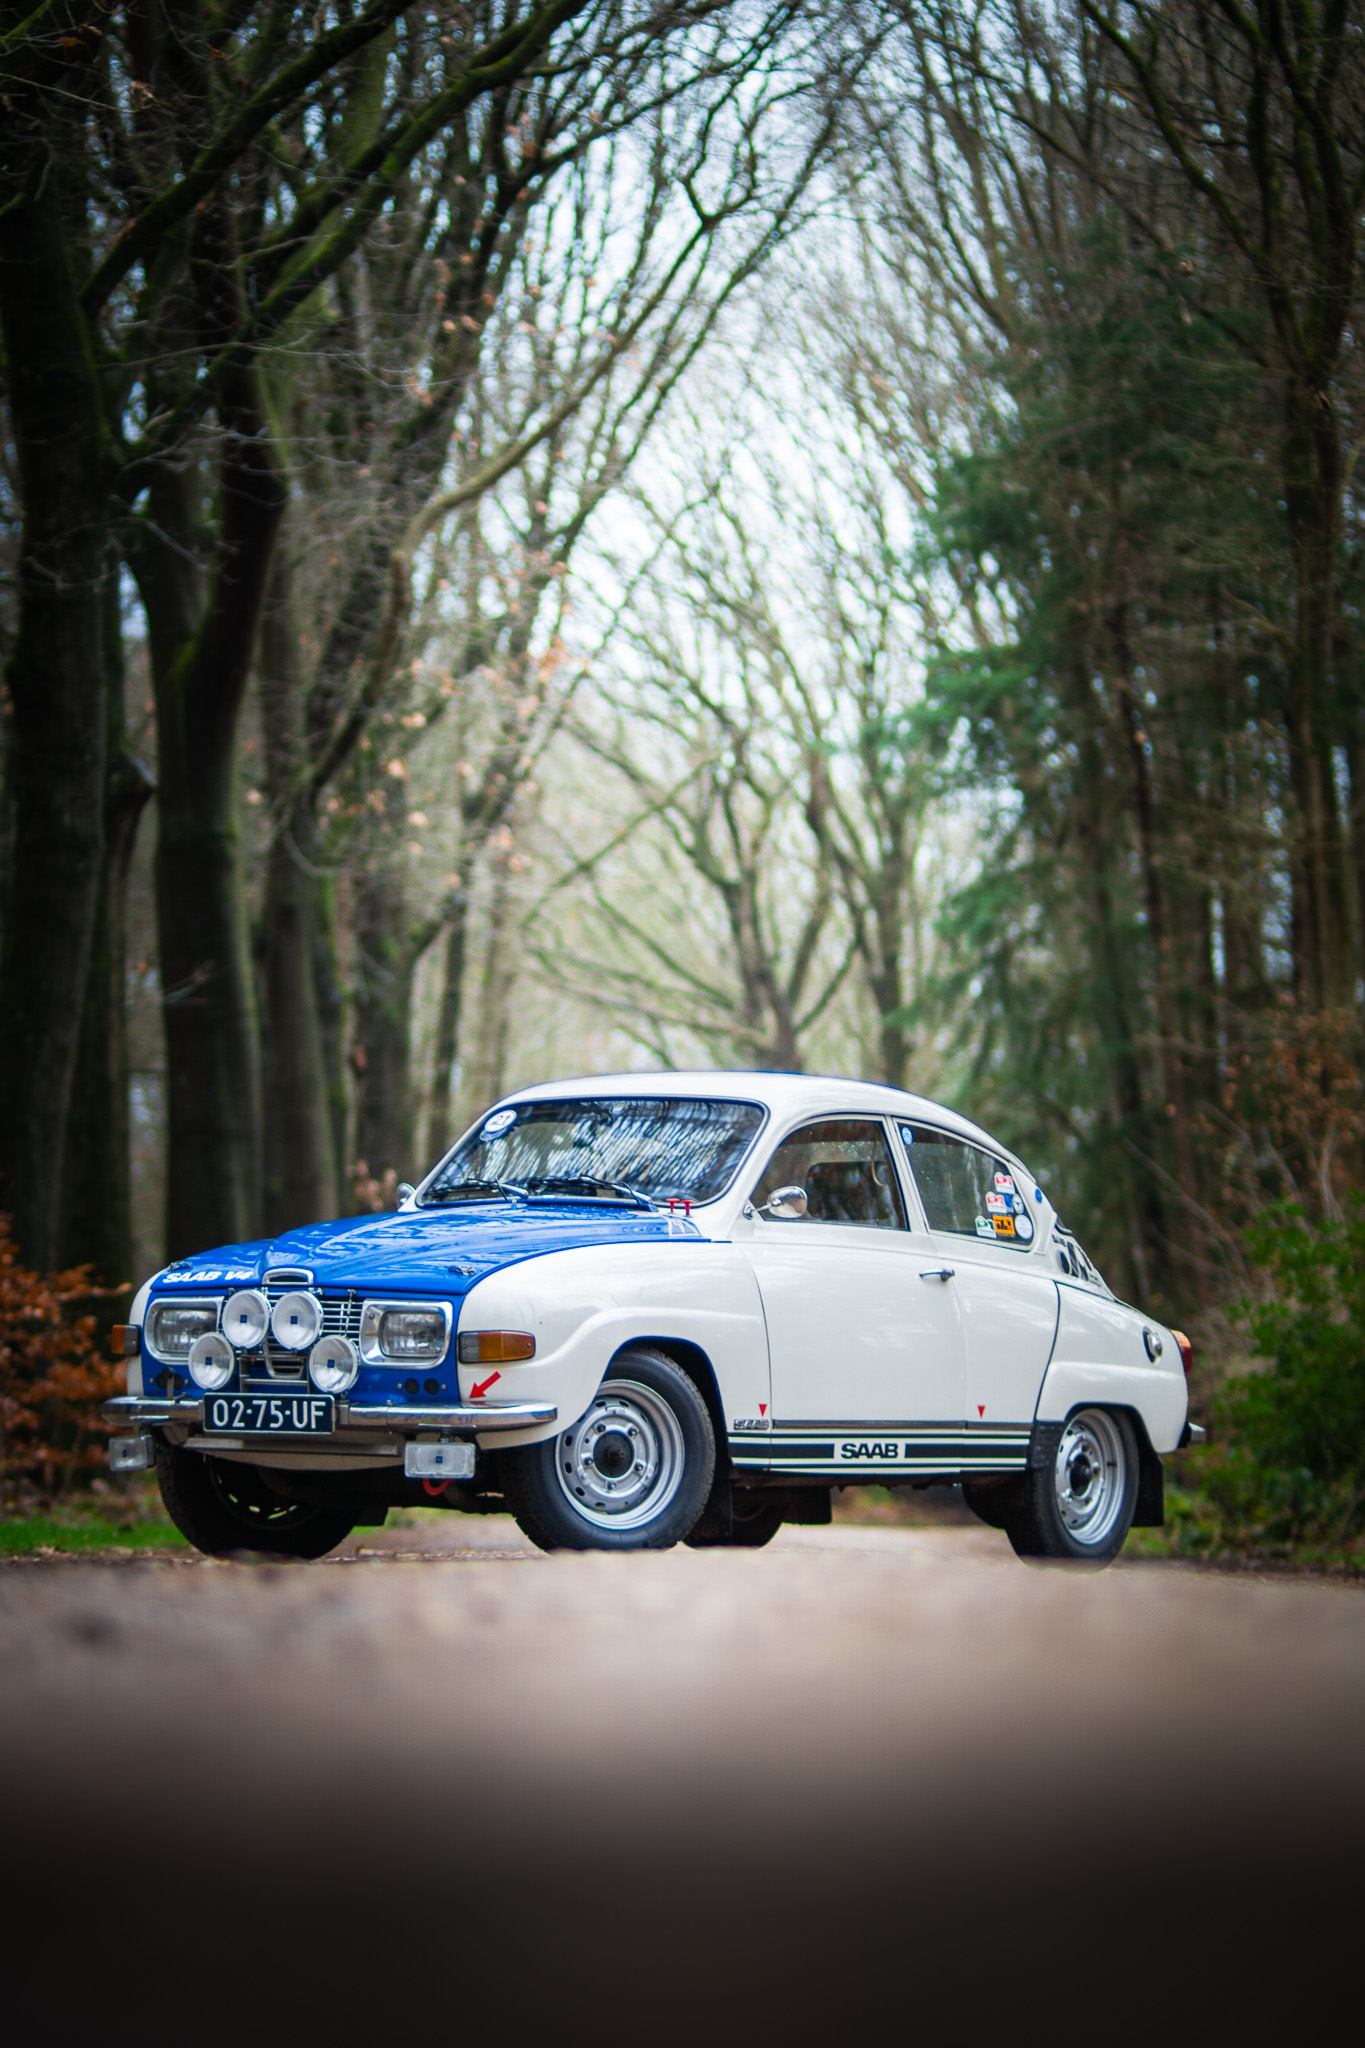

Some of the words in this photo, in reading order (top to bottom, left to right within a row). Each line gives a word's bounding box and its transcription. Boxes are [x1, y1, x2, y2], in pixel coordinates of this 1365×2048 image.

[163, 1271, 222, 1283] SAAB
[224, 1271, 254, 1281] V4
[841, 1443, 899, 1459] SAAB
